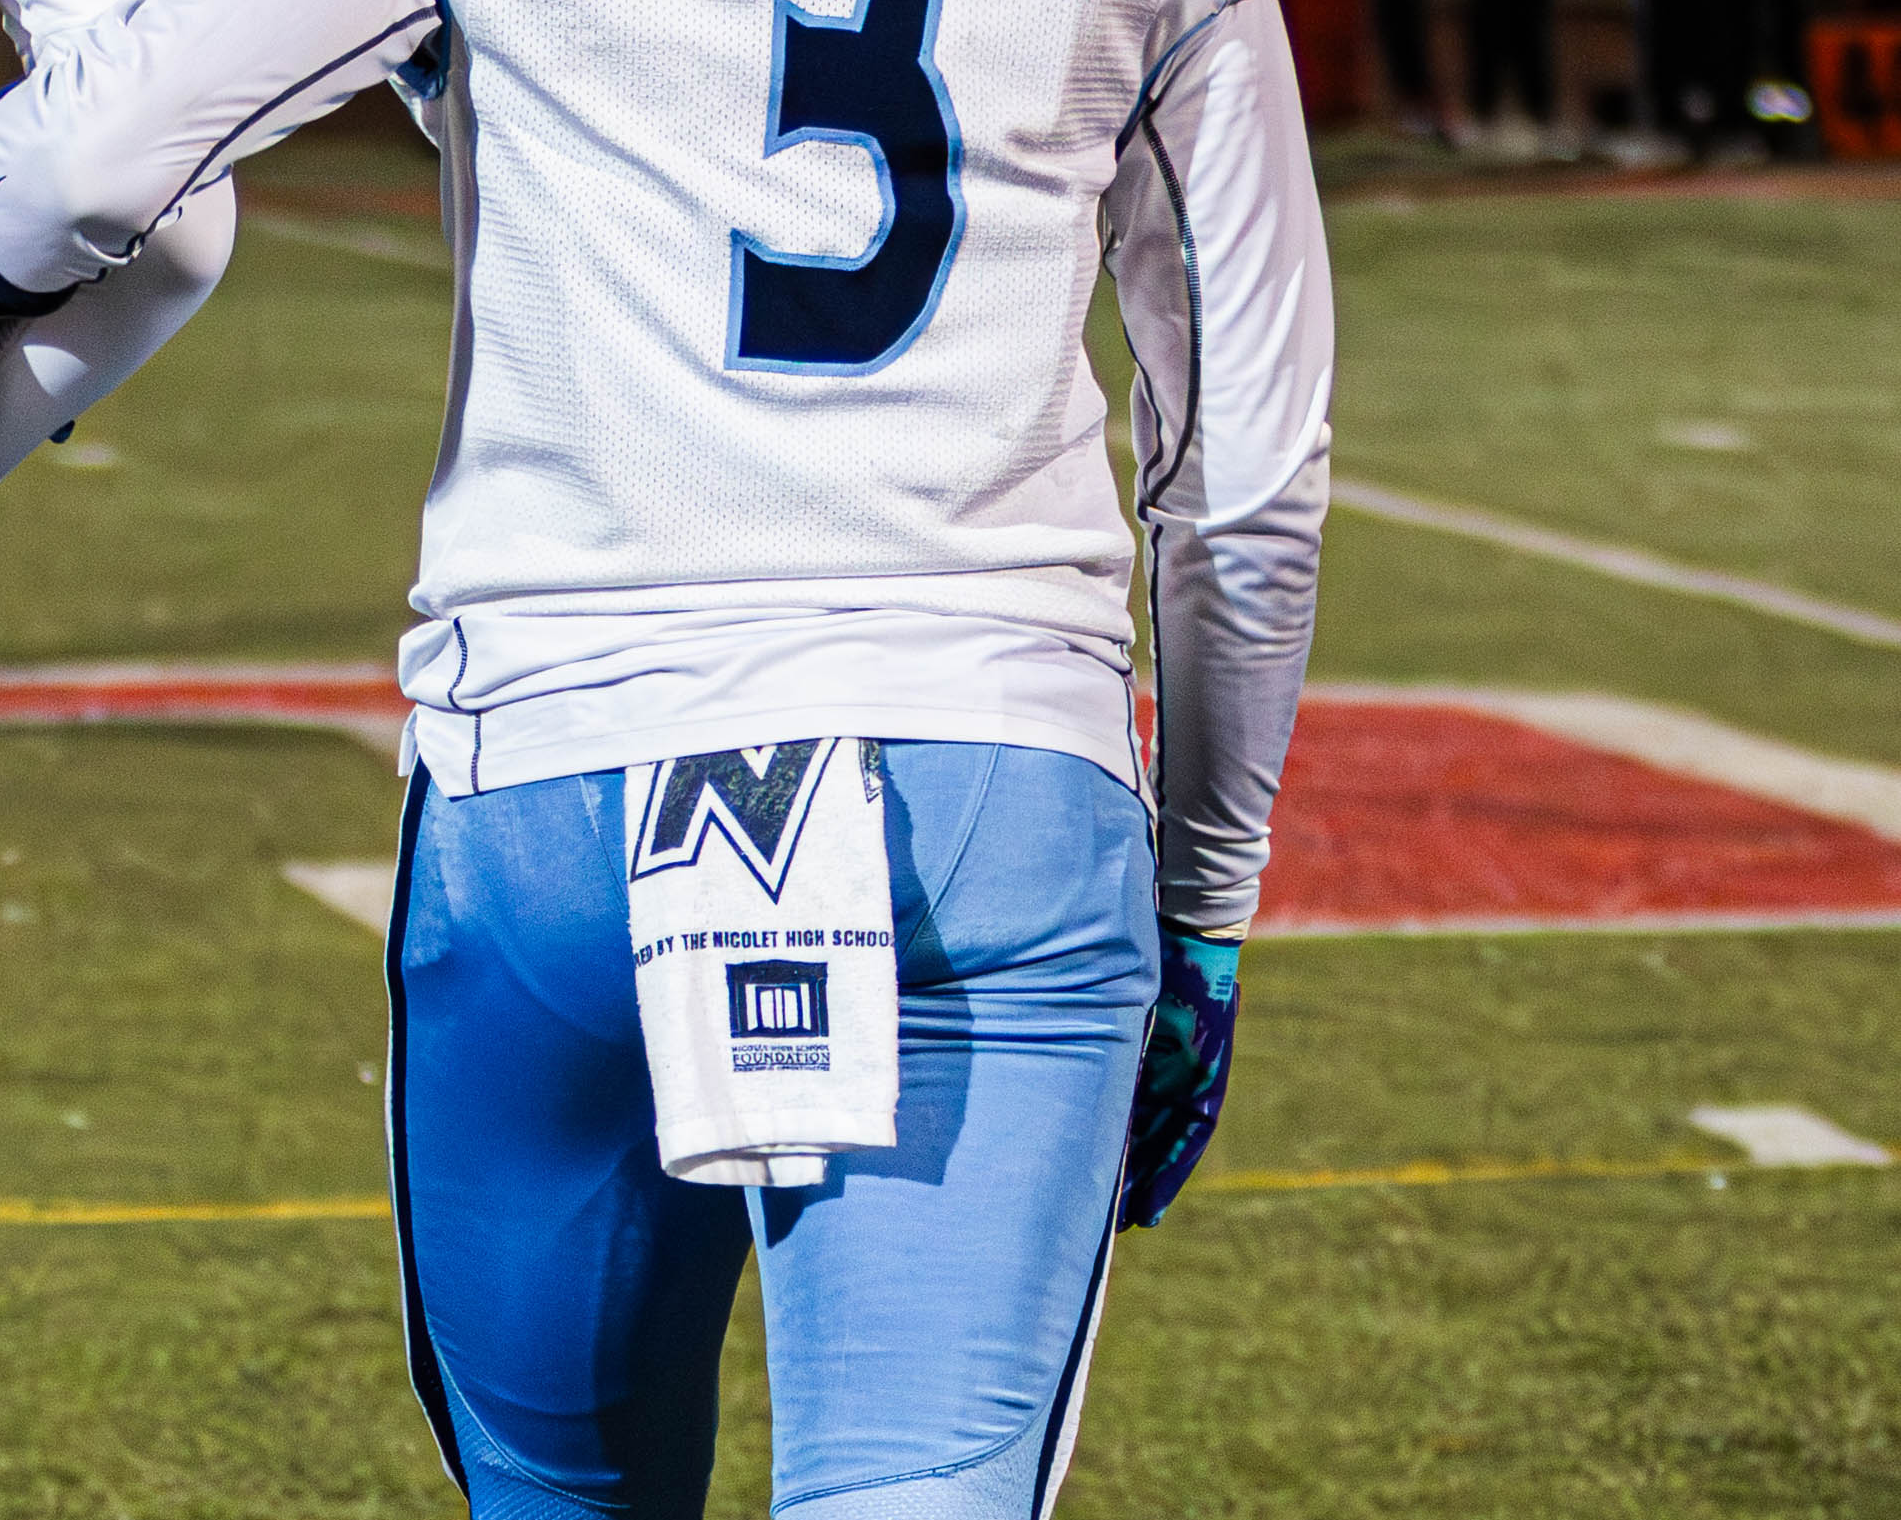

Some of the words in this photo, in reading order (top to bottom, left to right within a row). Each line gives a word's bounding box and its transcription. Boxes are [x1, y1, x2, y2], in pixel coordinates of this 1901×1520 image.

[656, 935, 675, 957] BY
[682, 931, 708, 952] THE
[713, 930, 778, 949] NICOLET
[786, 929, 825, 948] HIGH
[832, 929, 895, 948] SCHOO
[732, 1052, 831, 1065] FOUNDATION
